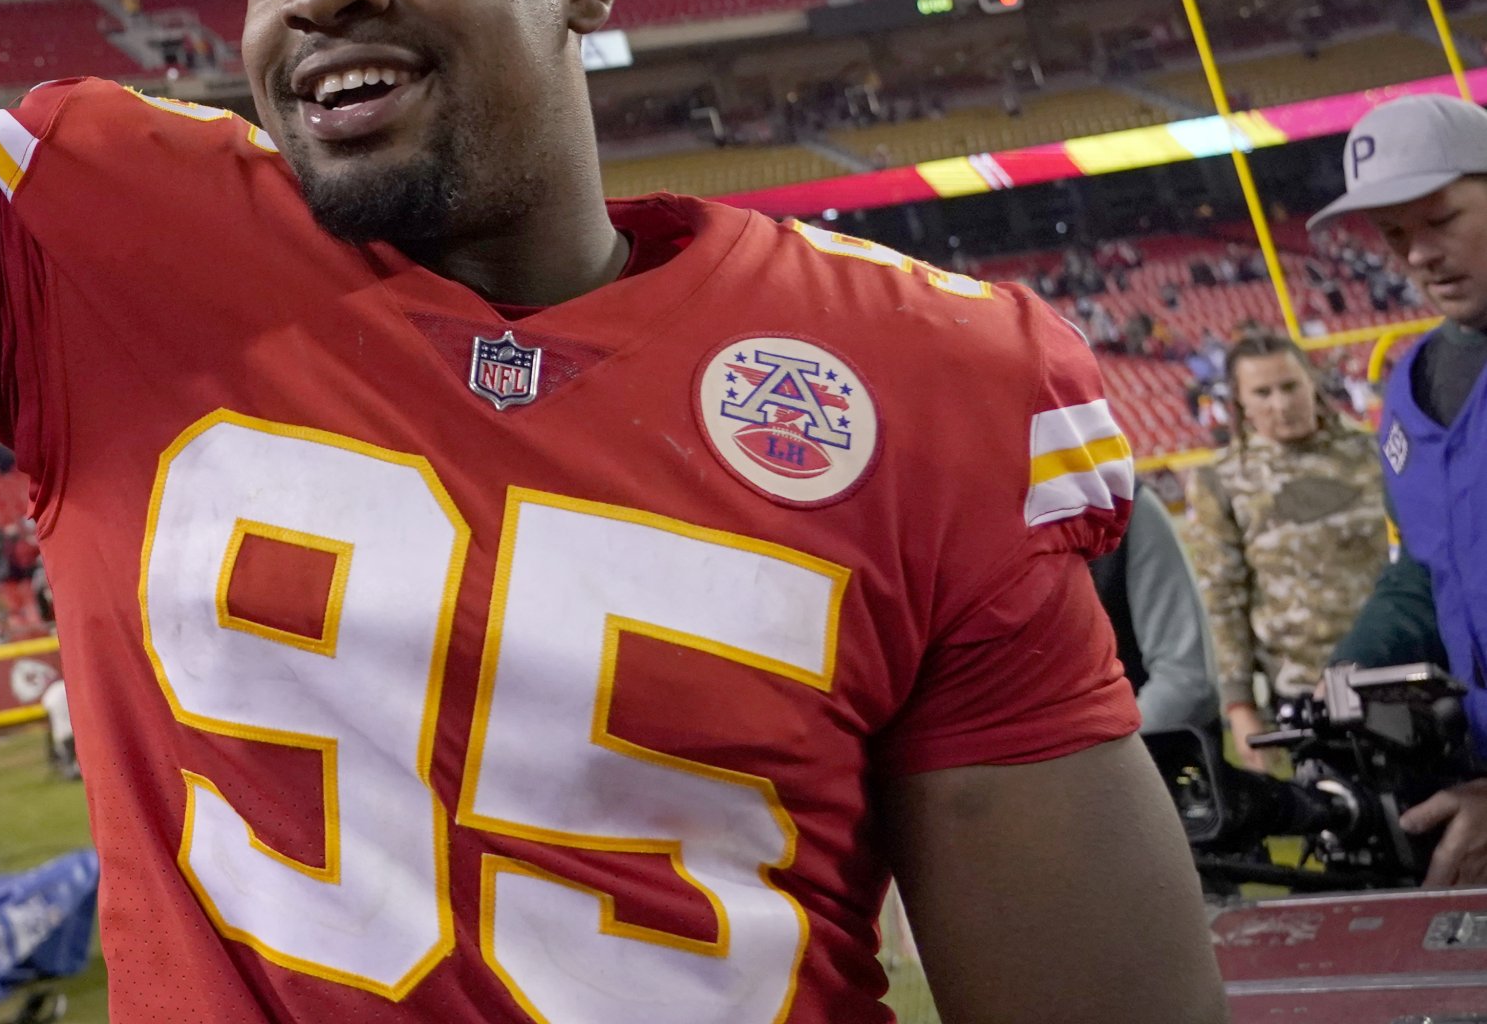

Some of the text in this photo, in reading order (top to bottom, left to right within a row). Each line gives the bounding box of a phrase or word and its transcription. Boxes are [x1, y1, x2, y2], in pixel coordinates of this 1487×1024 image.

[1352, 135, 1376, 180] P
[482, 362, 526, 395] NFL
[765, 436, 807, 466] LH
[137, 406, 852, 1024] 95
